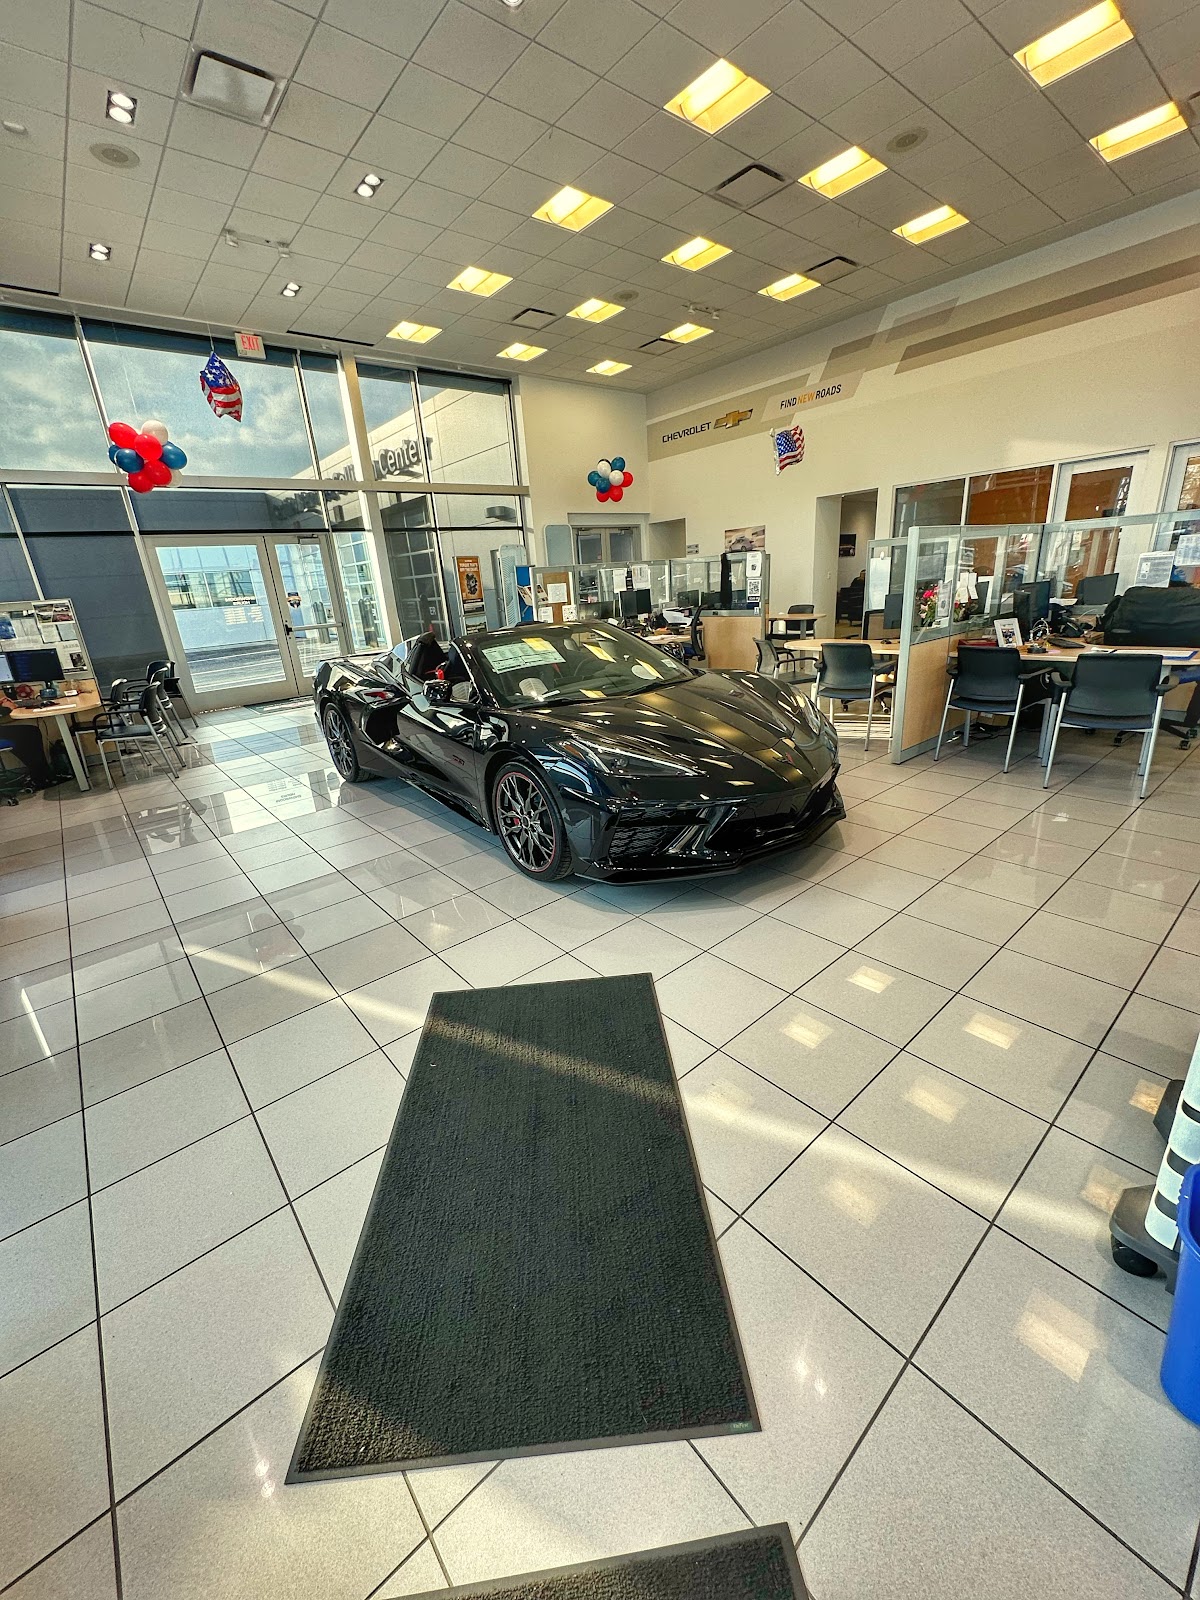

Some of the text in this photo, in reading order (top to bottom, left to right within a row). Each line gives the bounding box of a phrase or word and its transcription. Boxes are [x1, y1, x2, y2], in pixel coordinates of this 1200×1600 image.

[240, 334, 260, 351] EXIT
[780, 384, 842, 410] FIND NEW ROADS
[662, 421, 712, 443] CHEVROLET
